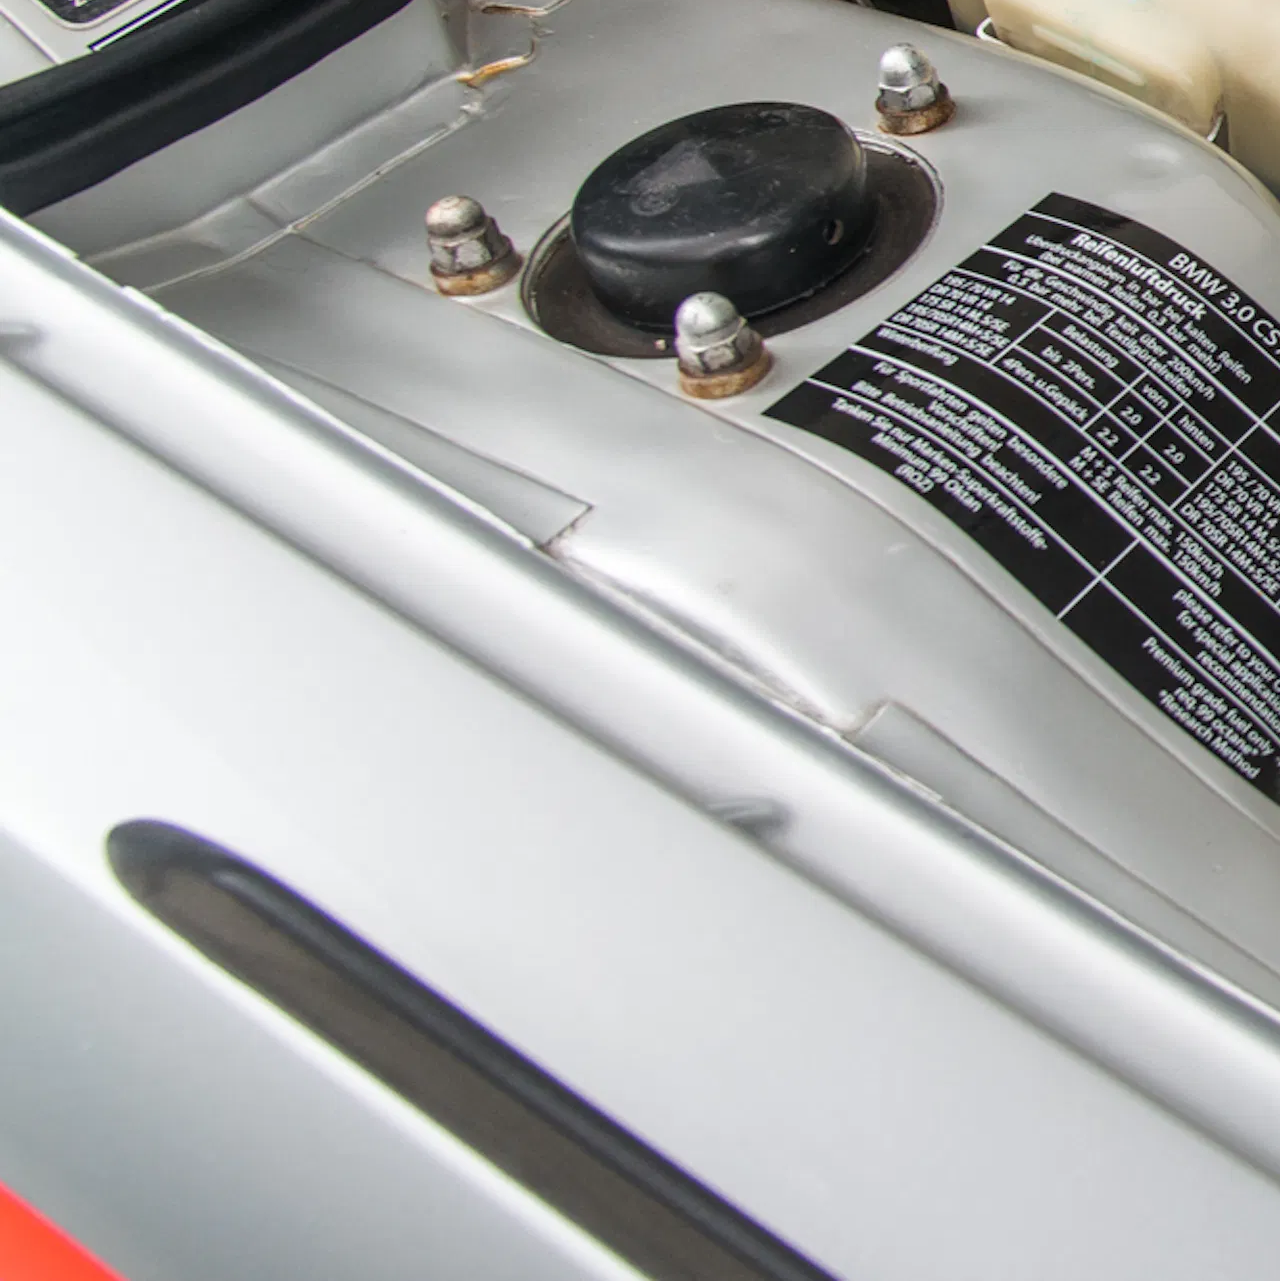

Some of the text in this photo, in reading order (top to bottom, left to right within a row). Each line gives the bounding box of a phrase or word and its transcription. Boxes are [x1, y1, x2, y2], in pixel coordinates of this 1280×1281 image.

[1071, 233, 1206, 320] Reifenluftdruck
[1168, 253, 1227, 295] BMW
[1220, 292, 1255, 322] 3,0
[1041, 345, 1062, 363] bis
[1062, 324, 1118, 368] Belastung
[1217, 351, 1251, 383] Reifen
[1142, 384, 1168, 409] vorn
[1166, 356, 1214, 400] 200km/h
[1096, 427, 1118, 446] 2.2
[1120, 406, 1141, 425] 2.0
[1178, 414, 1214, 450] hinten
[1006, 435, 1073, 488] besondere
[1139, 465, 1160, 485] 2.2
[1163, 444, 1184, 464] 2.0
[1213, 470, 1277, 528] DR 70 VR 14
[1227, 460, 1249, 482] 195
[1252, 483, 1270, 501] 70
[1069, 456, 1086, 471] M
[1091, 475, 1110, 493] SE
[1107, 490, 1144, 526] Reifen
[1143, 525, 1170, 552] max.
[1173, 550, 1221, 596] 150km/h
[1079, 446, 1097, 462] M
[1101, 465, 1115, 477] S
[1112, 475, 1148, 510] Reifen
[1146, 507, 1173, 534] max.
[1175, 531, 1223, 578] 150km/h
[1180, 503, 1228, 547] DR 70SR
[1204, 482, 1227, 504] 175
[1223, 499, 1242, 518] SR
[1239, 513, 1256, 530] 14
[1172, 589, 1212, 623] please
[1209, 621, 1238, 646] refer
[1235, 643, 1251, 659] to
[1246, 655, 1275, 681] your
[1177, 610, 1197, 629] for
[1193, 627, 1235, 664] special
[1142, 637, 1274, 756] Premium grade fuel only
[1169, 687, 1215, 721] req. 99
[1210, 736, 1259, 778] Method
